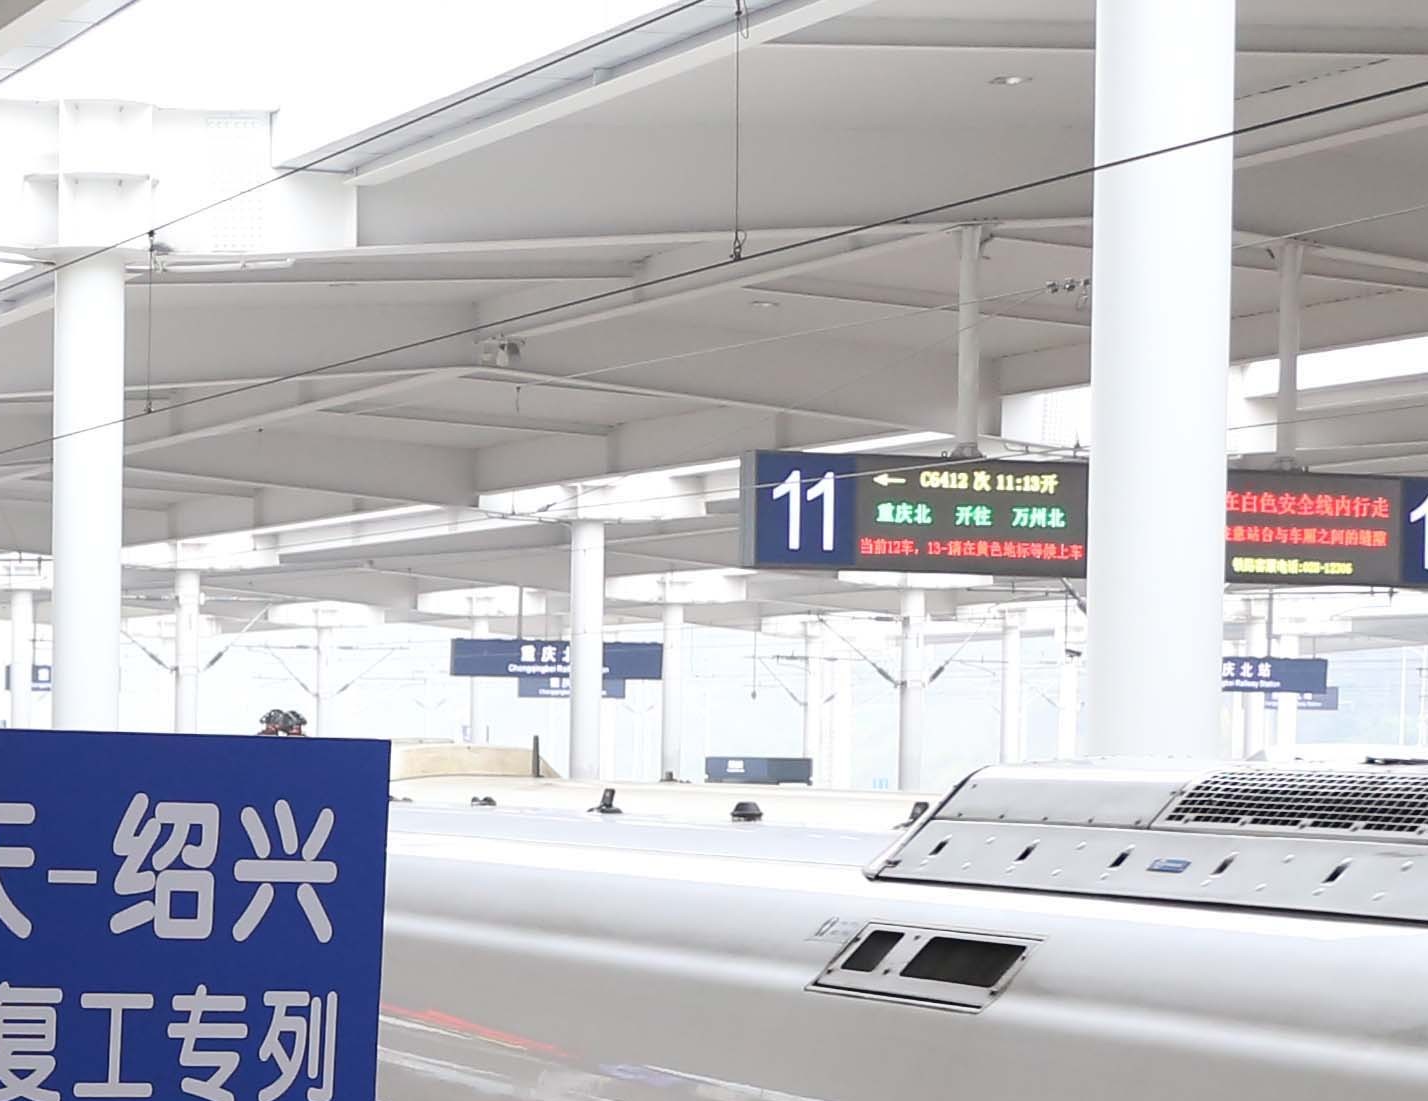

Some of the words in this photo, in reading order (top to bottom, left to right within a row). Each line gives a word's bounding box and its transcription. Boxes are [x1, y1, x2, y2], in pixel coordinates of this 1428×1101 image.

[772, 469, 836, 551] 11
[876, 502, 932, 524] 重庆北
[955, 506, 992, 526] 开往
[1012, 507, 1066, 528] 万州北
[1222, 661, 1272, 678] 庆北站
